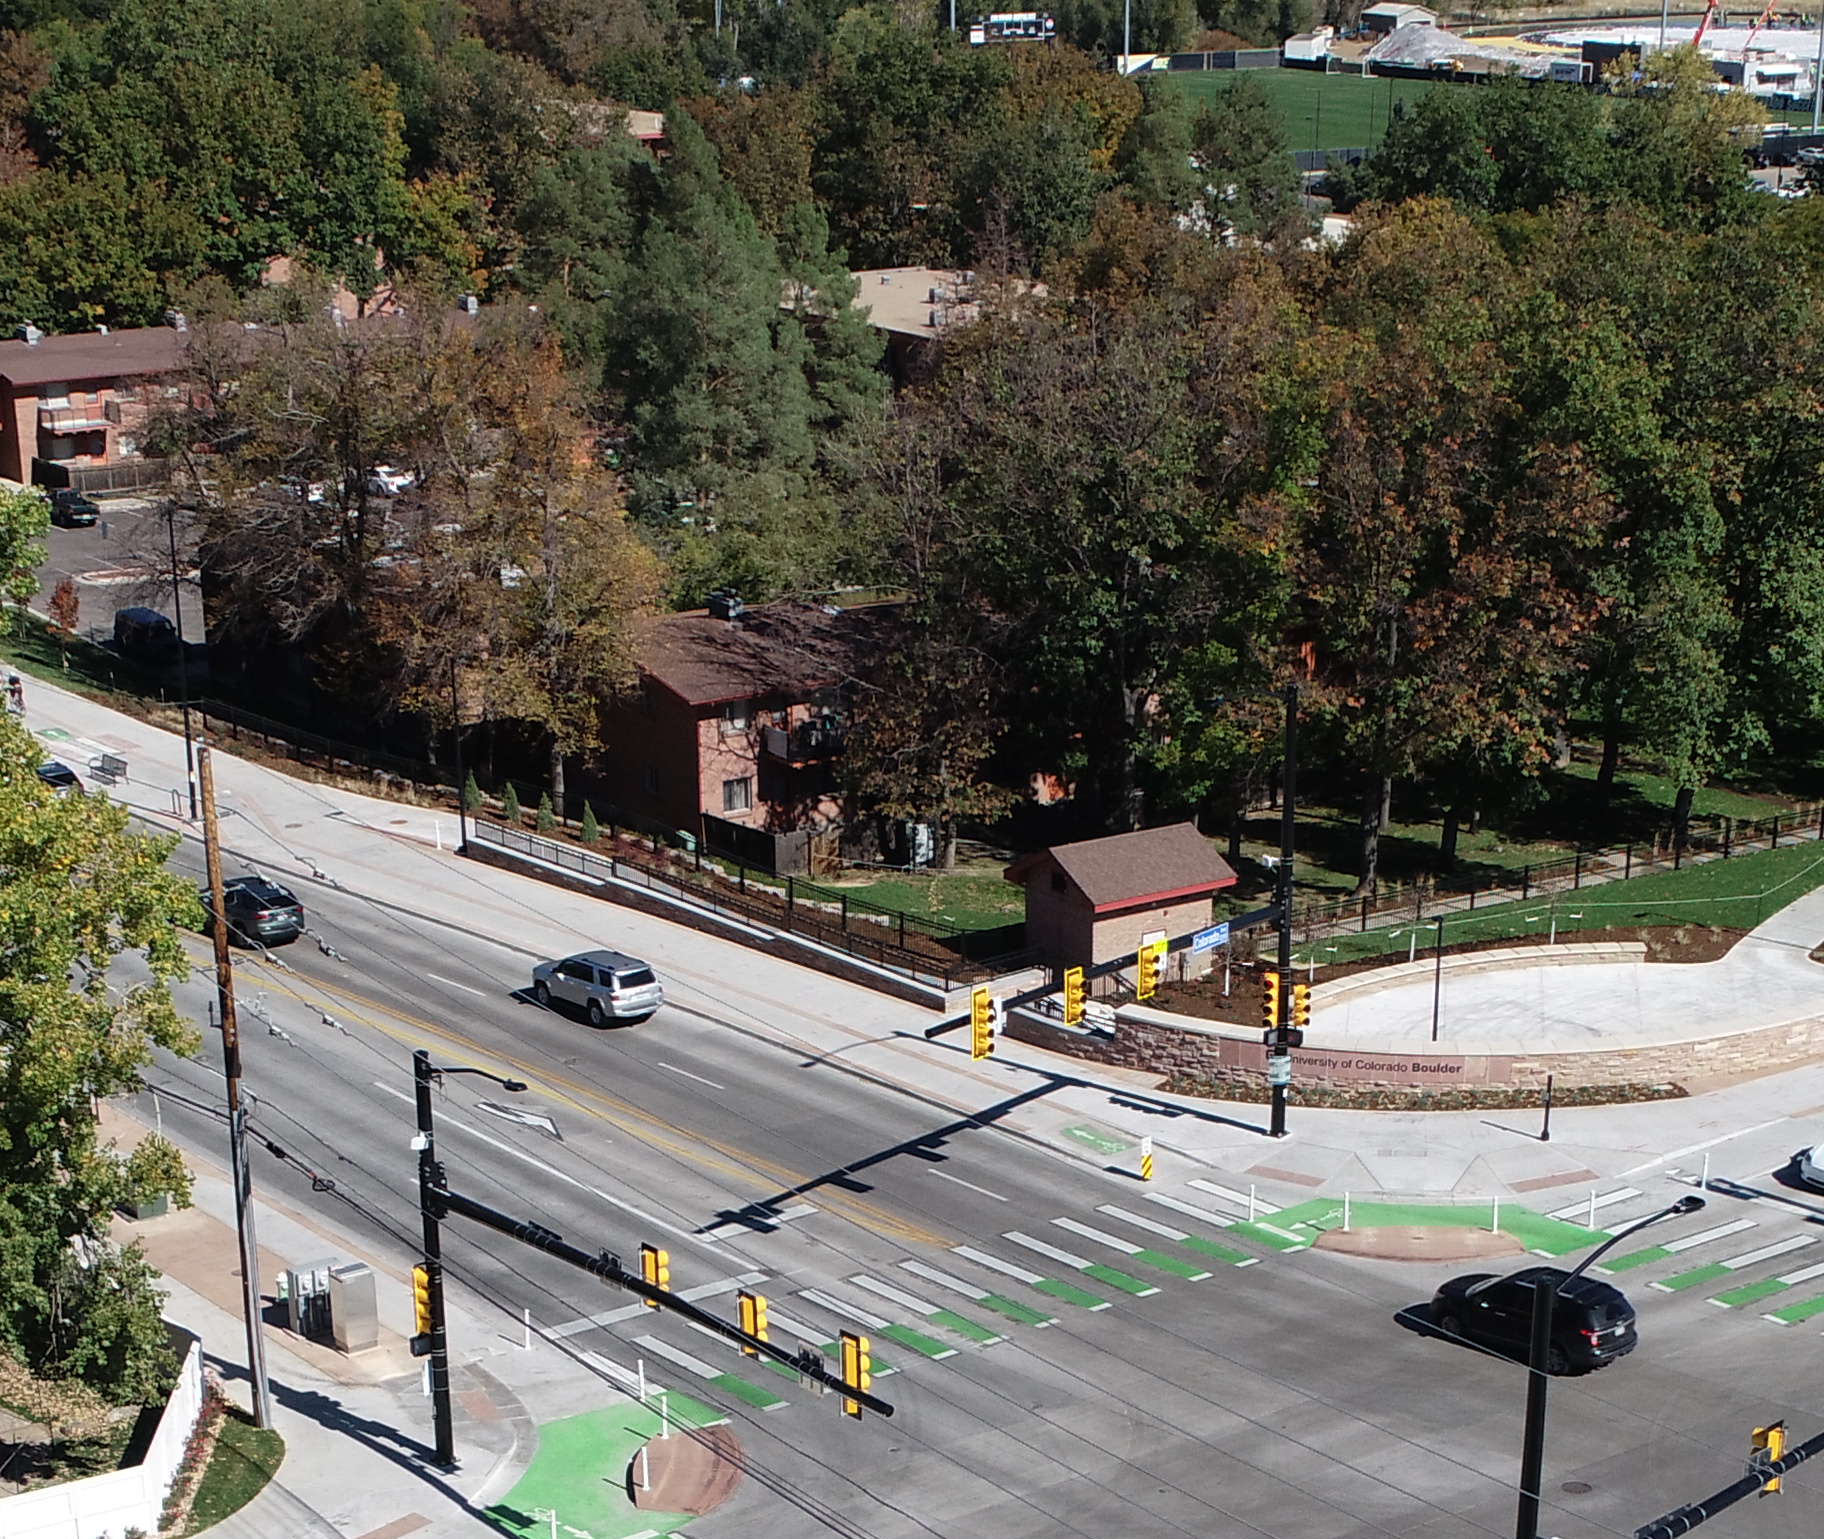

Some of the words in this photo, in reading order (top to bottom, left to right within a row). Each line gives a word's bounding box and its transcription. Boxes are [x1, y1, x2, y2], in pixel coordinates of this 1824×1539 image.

[1195, 930, 1220, 949] Colorado
[1290, 1055, 1338, 1069] niversity
[1341, 1060, 1353, 1068] of
[1355, 1059, 1408, 1072] Colorado
[1412, 1062, 1462, 1074] Boulder
